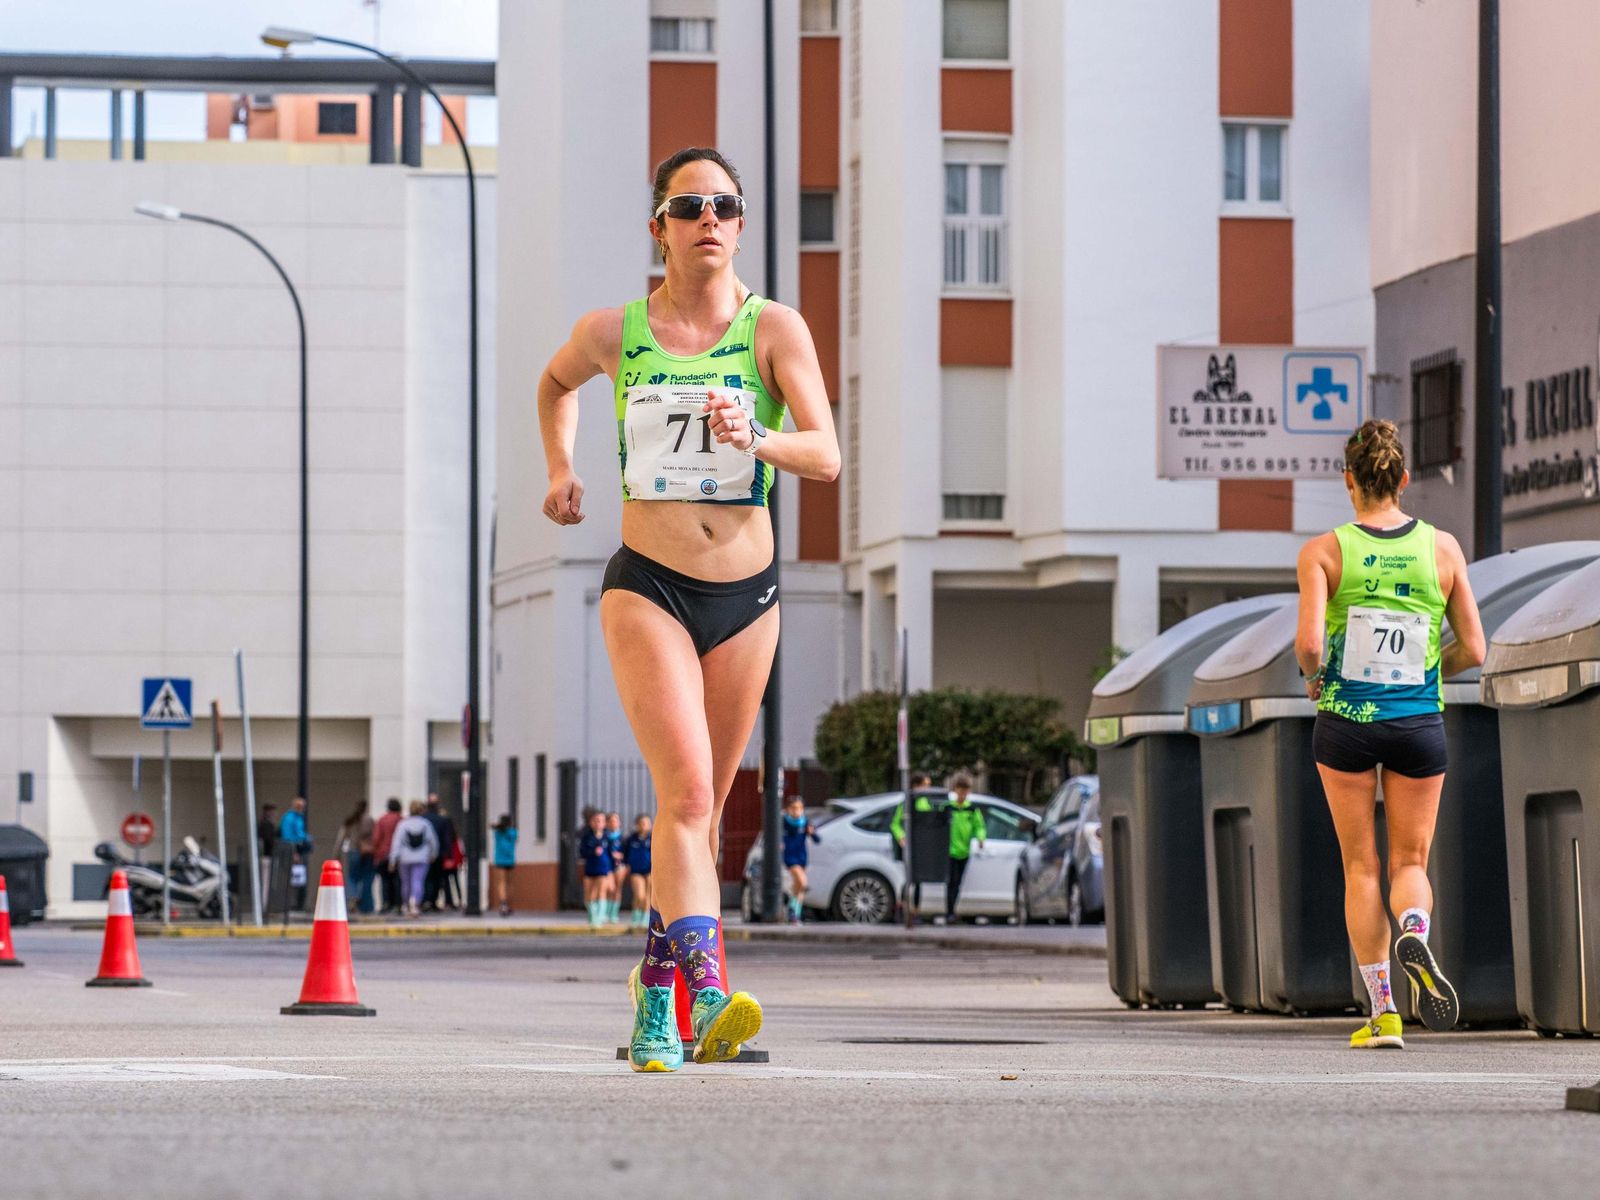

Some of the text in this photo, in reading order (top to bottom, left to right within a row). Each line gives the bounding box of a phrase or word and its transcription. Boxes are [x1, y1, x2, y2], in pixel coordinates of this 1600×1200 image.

[670, 372, 718, 381] Fundación
[1526, 366, 1592, 440] ARENAL
[1170, 407, 1276, 424] EL ARENAL
[666, 413, 716, 454] 71
[1179, 428, 1266, 437] Centro Veterinario
[1220, 458, 1257, 471] 956
[1264, 458, 1300, 471] 895
[1309, 458, 1345, 471] 770
[1380, 561, 1407, 570] Unicaja
[1373, 628, 1405, 655] 70
